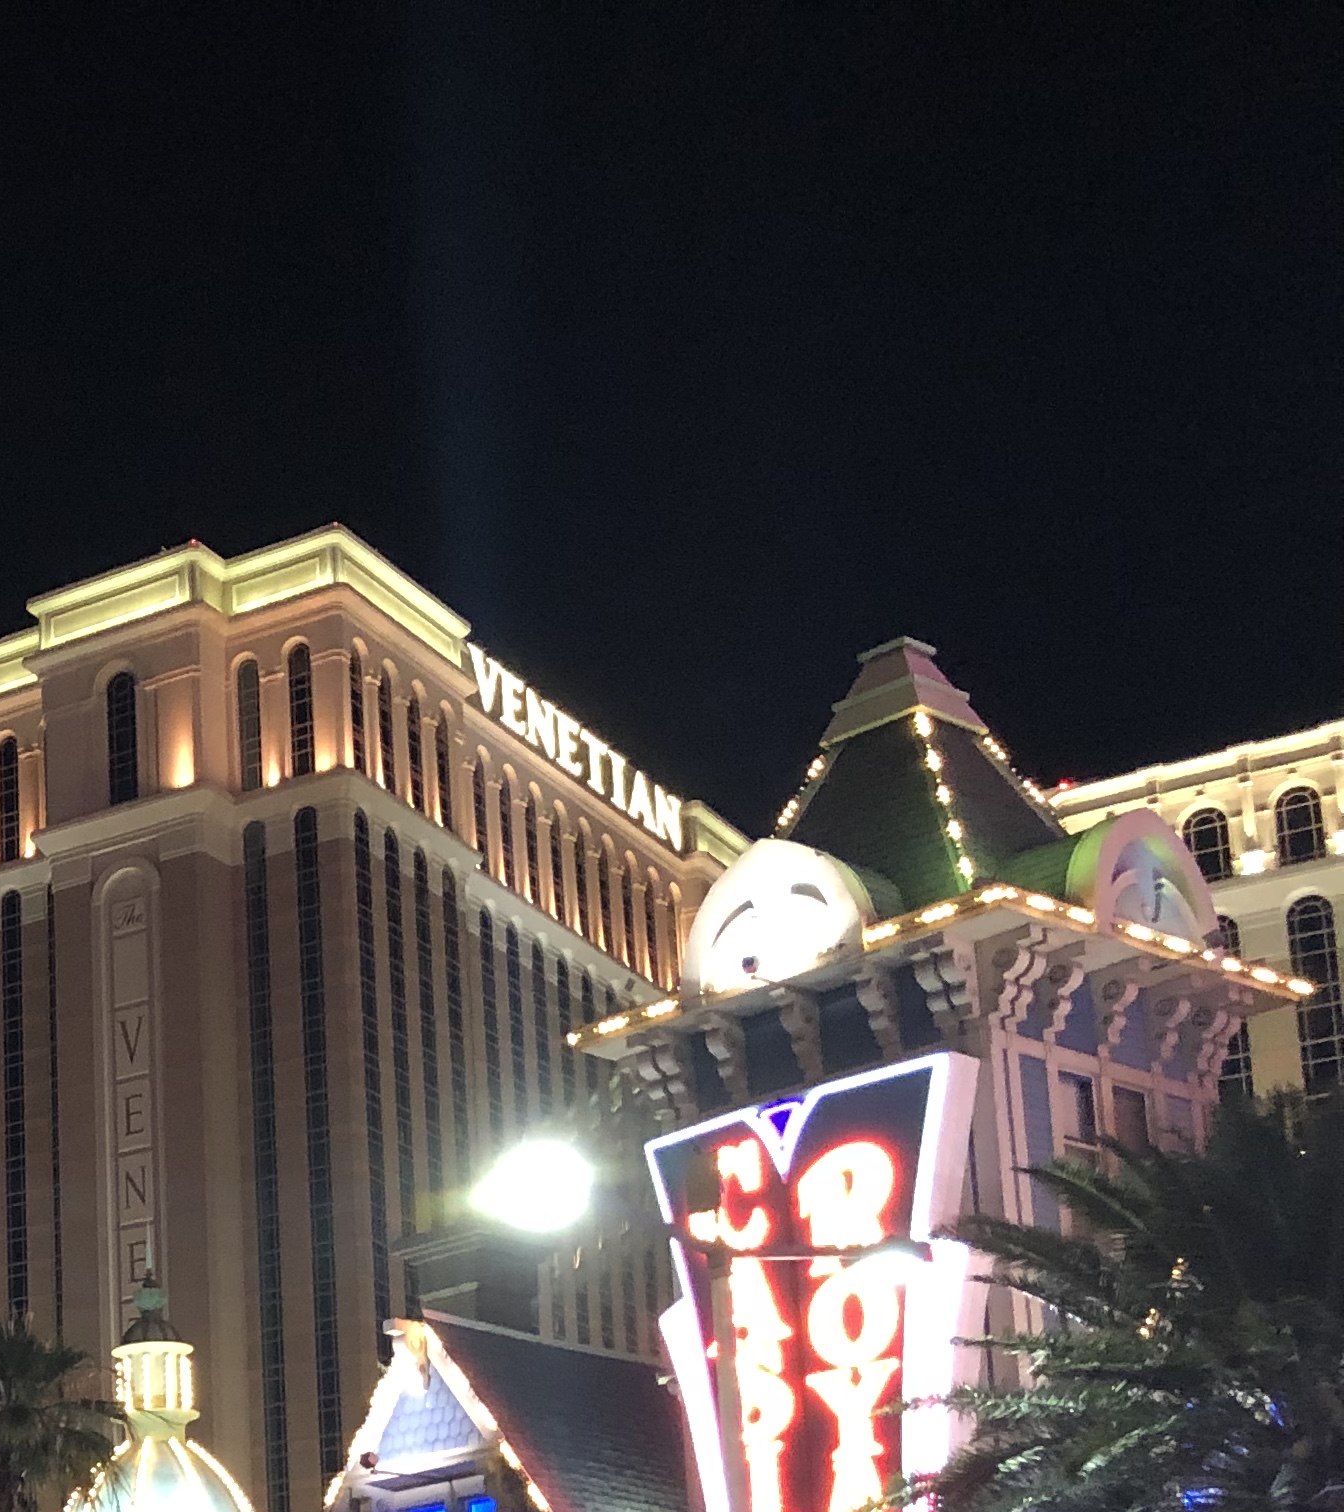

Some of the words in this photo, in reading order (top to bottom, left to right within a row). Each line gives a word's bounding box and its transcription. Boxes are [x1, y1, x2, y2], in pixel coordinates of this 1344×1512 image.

[467, 642, 682, 852] VENETIAN
[115, 904, 143, 930] The
[118, 1014, 148, 1322] VENE
